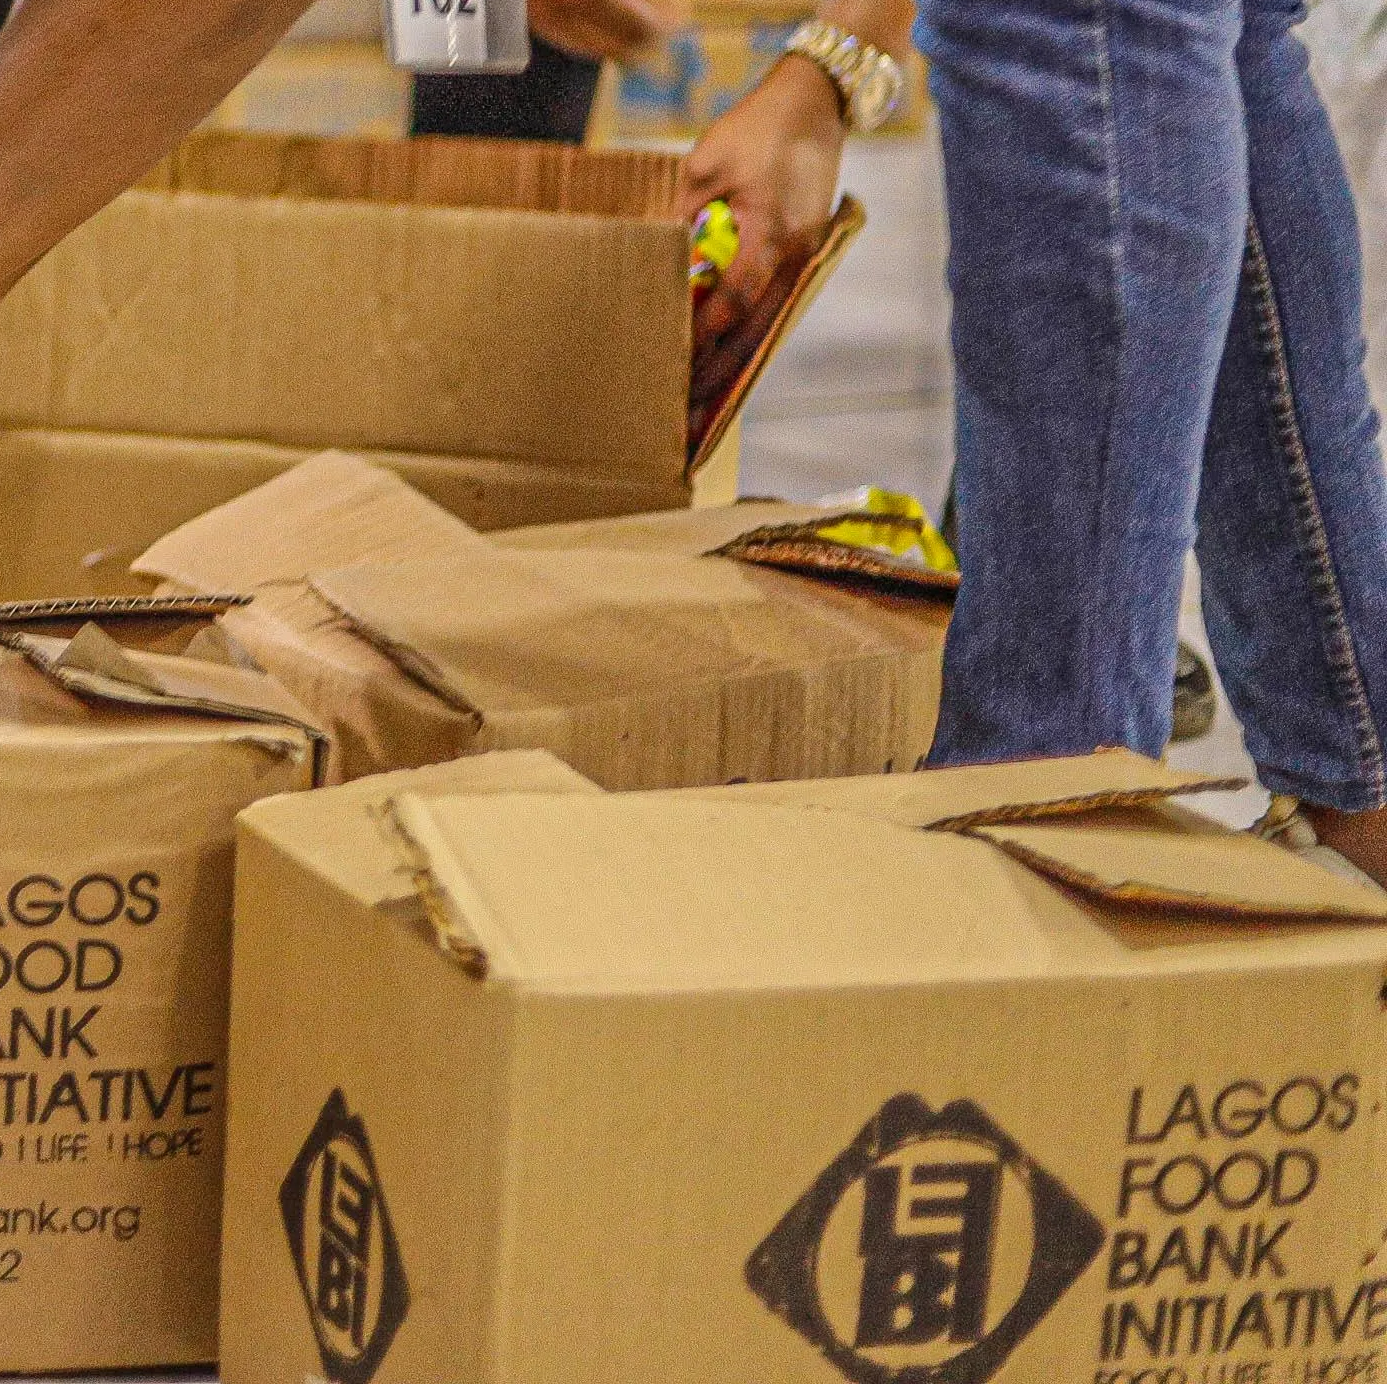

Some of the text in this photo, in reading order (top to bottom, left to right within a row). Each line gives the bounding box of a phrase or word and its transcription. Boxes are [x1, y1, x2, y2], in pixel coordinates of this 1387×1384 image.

[1126, 1071, 1361, 1146] LAGOS
[35, 1132, 89, 1165] LIFE
[122, 1126, 204, 1164] HOPE
[1118, 1148, 1322, 1218] FOOD
[1107, 1219, 1294, 1292] BANK
[1099, 1278, 1387, 1362] INITIATIVE
